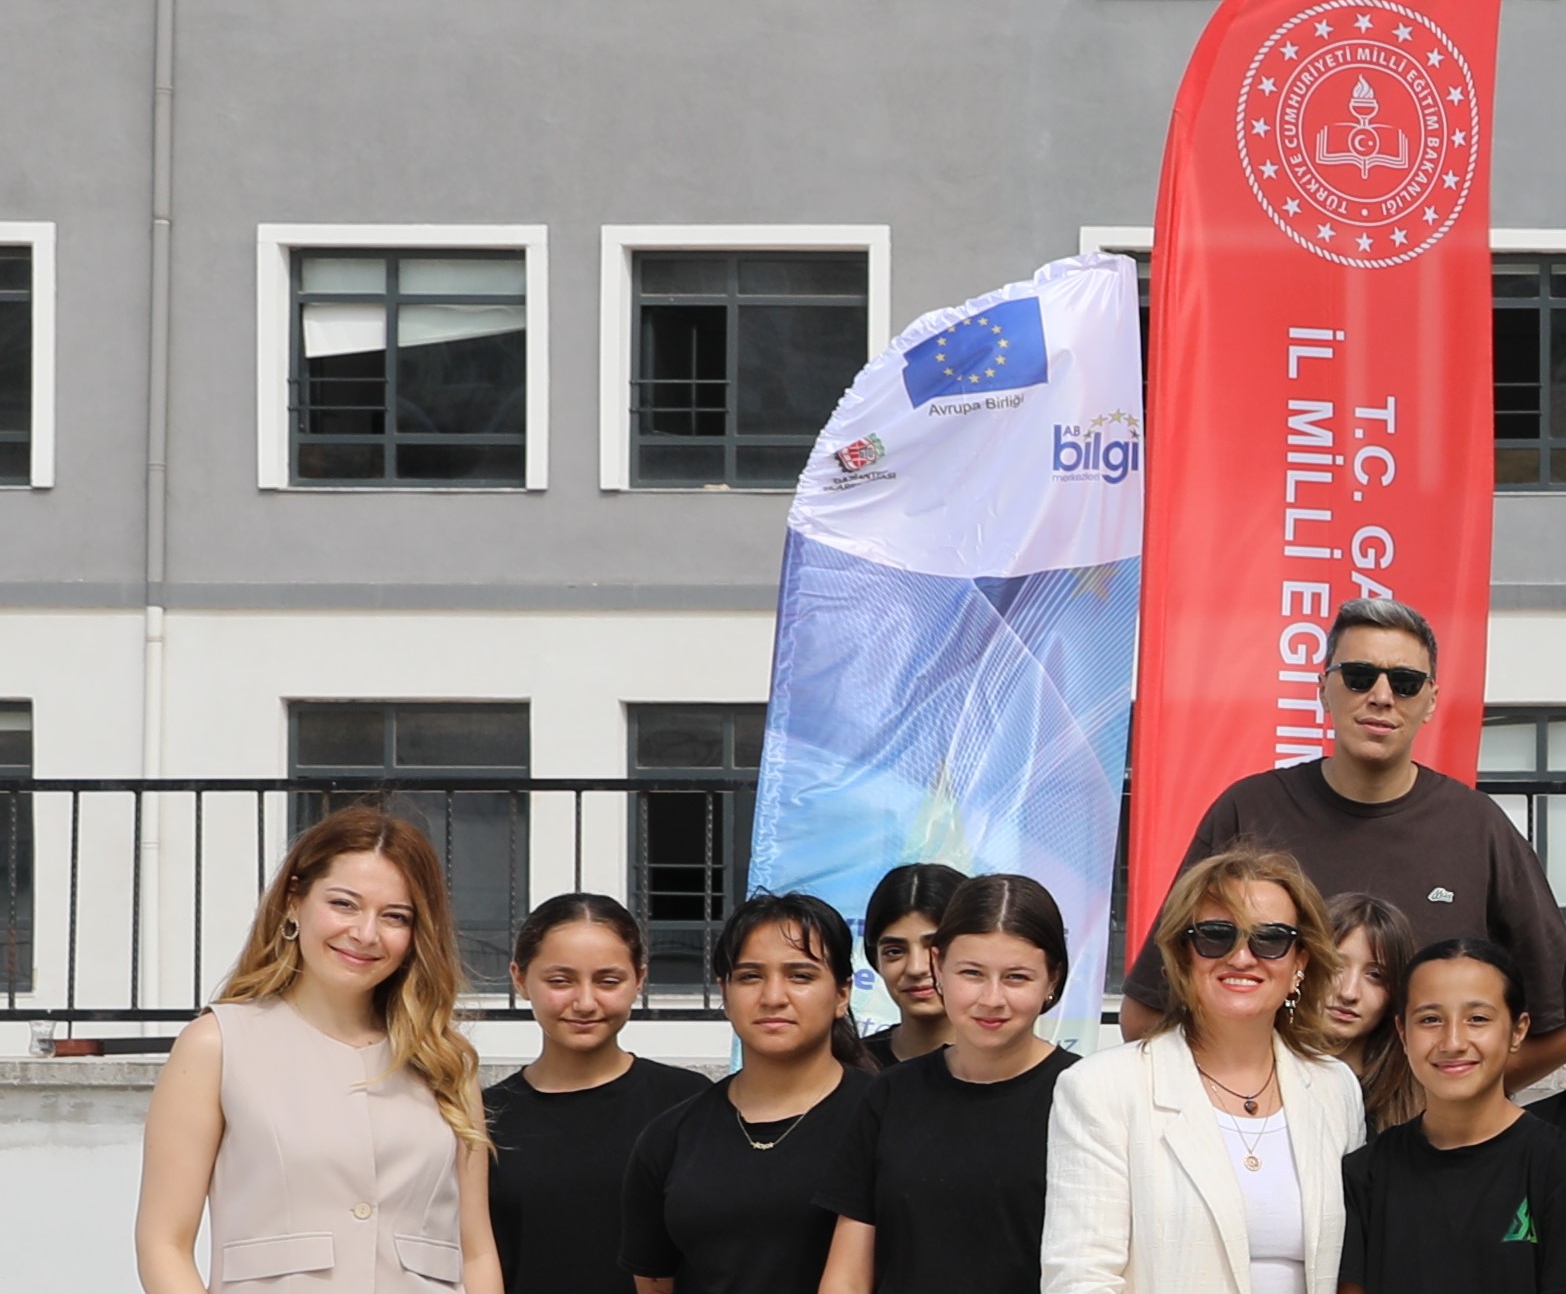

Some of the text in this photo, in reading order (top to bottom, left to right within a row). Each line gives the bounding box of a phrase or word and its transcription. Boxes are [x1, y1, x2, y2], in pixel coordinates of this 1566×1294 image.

[1283, 45, 1440, 216] TÜRKİYE CUMHURİYETİ MİLLİ EĞİTİM BAKANLIĞI
[1288, 326, 1346, 379] İL
[928, 399, 981, 417] Avrupa
[1063, 425, 1081, 437] AB
[1052, 424, 1140, 485] bilgi
[1352, 395, 1397, 502] T.C.
[1284, 399, 1345, 560] MİLLİ
